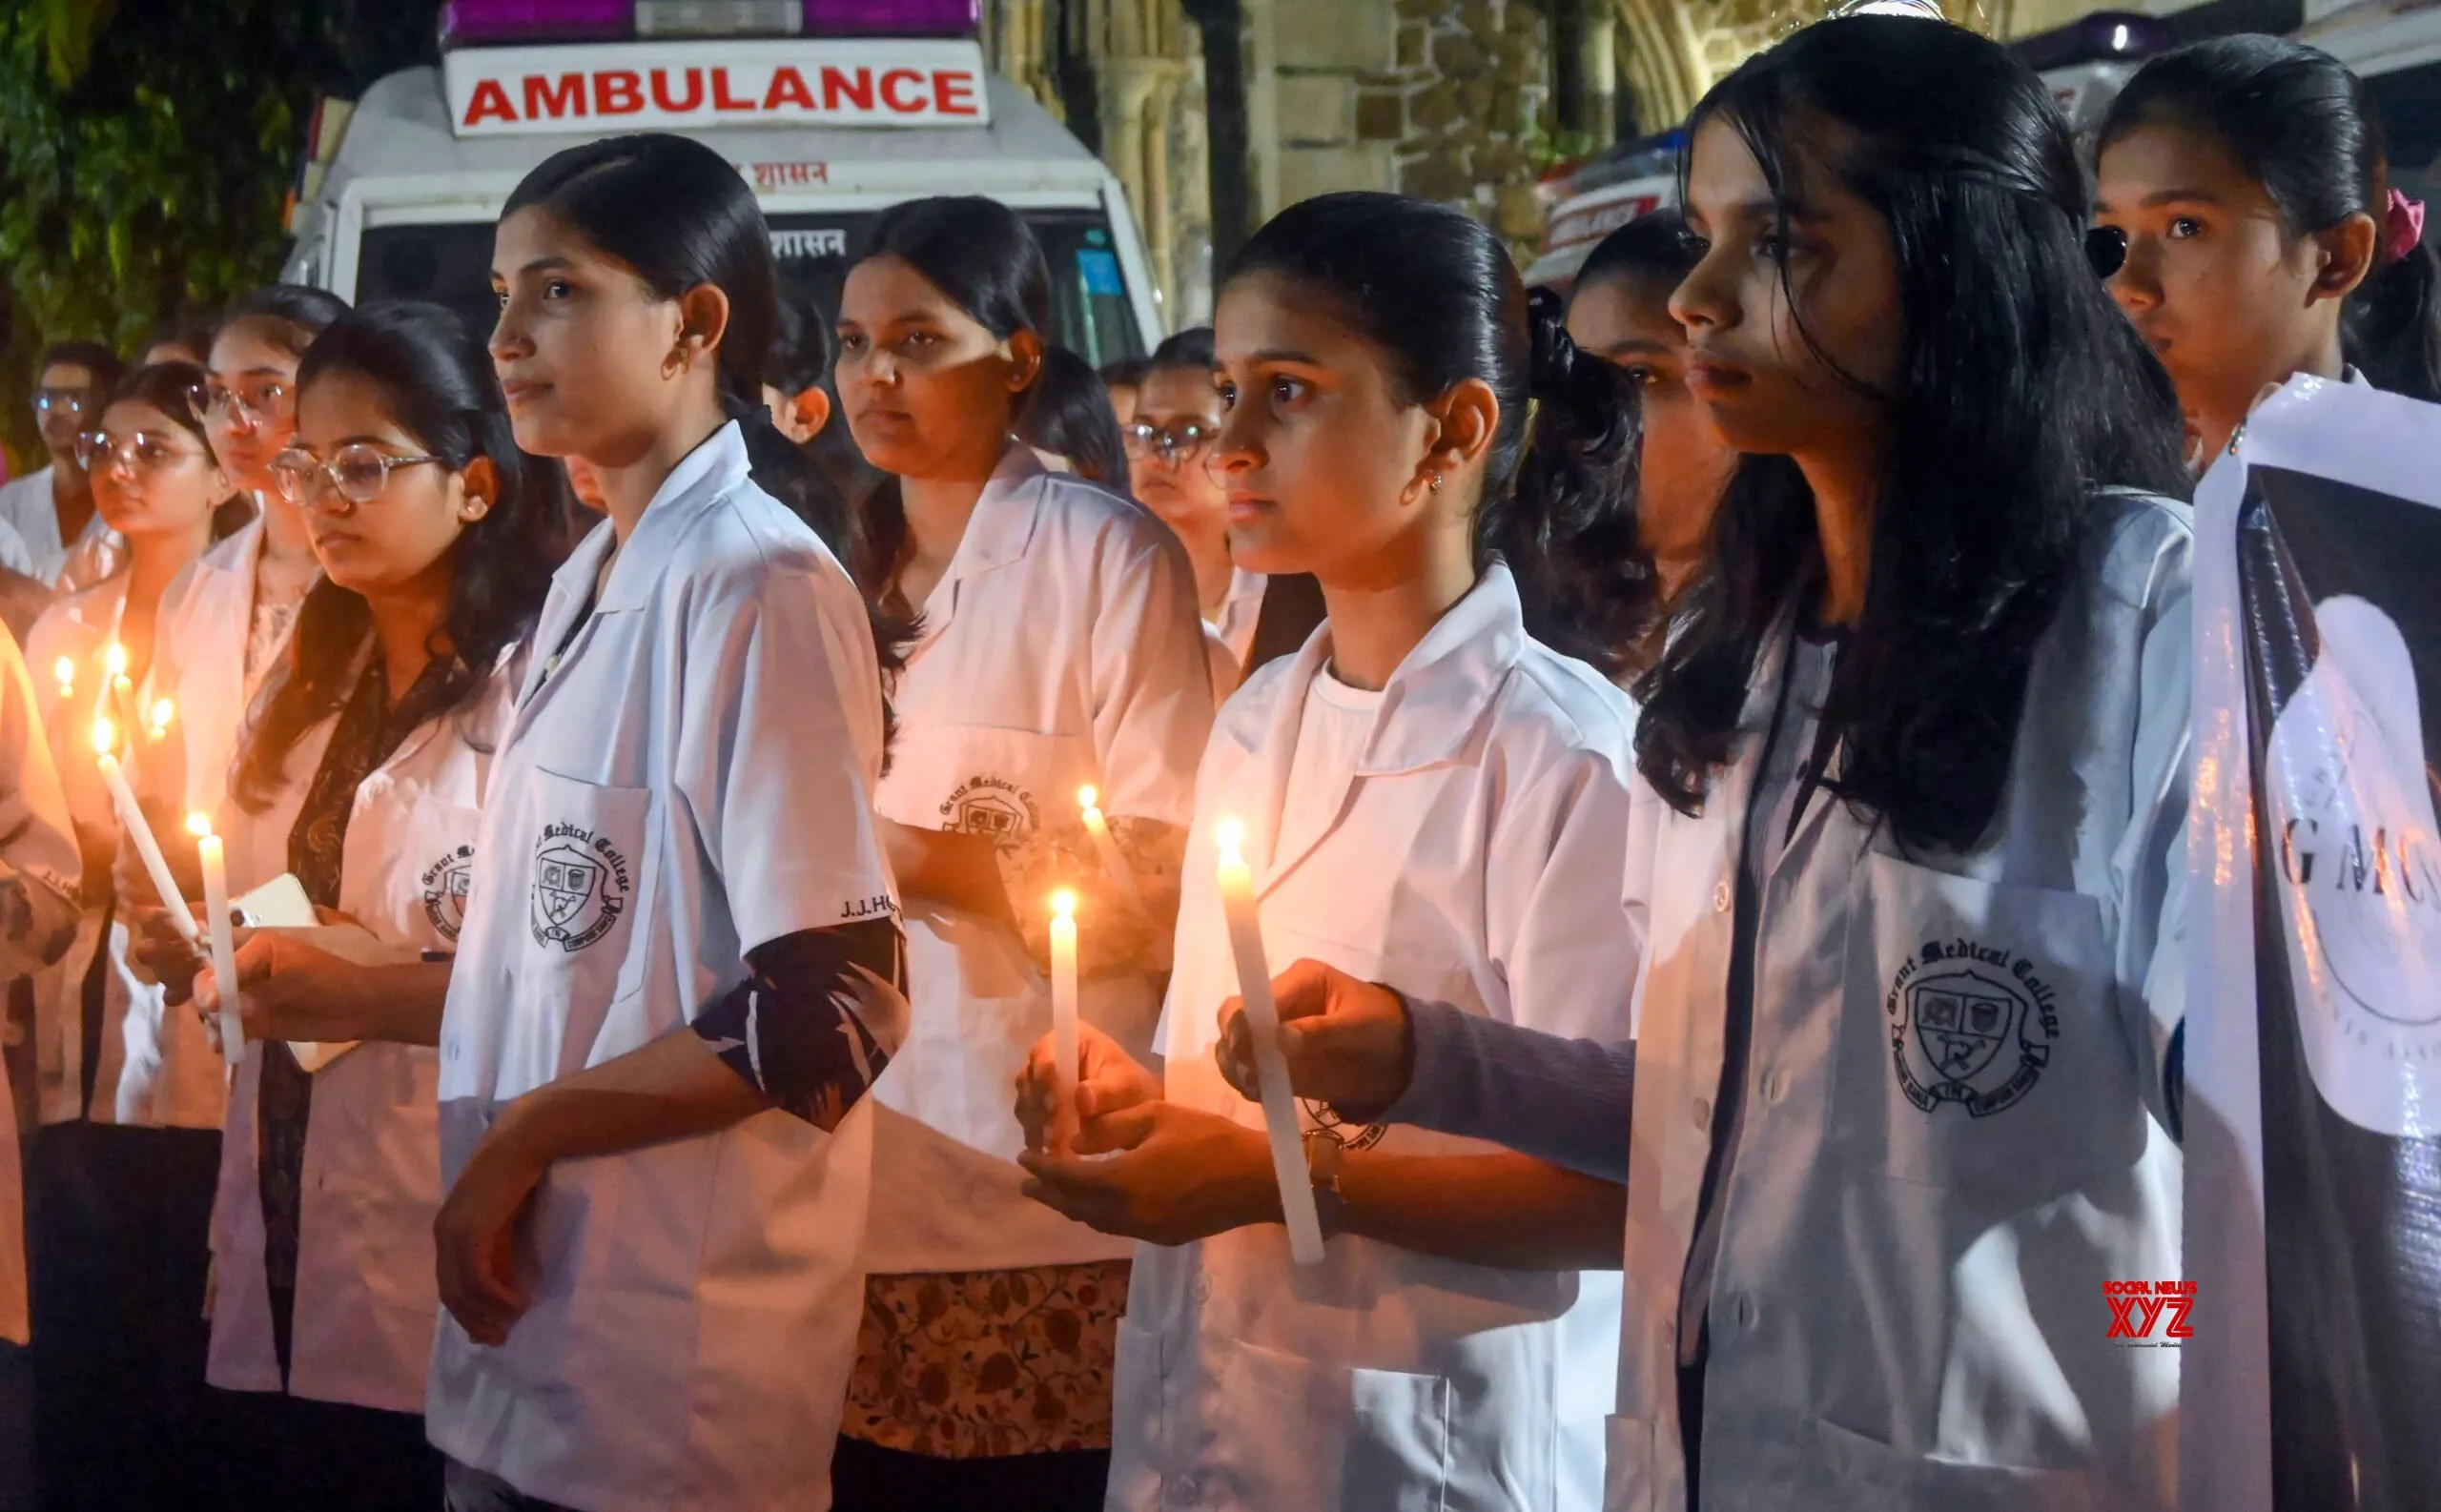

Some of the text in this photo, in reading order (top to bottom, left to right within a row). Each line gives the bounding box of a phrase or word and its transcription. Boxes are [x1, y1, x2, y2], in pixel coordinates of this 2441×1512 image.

[462, 66, 979, 127] AMBULANCE
[544, 821, 630, 894] Medical College
[1886, 937, 2061, 1040] Grant Medical College
